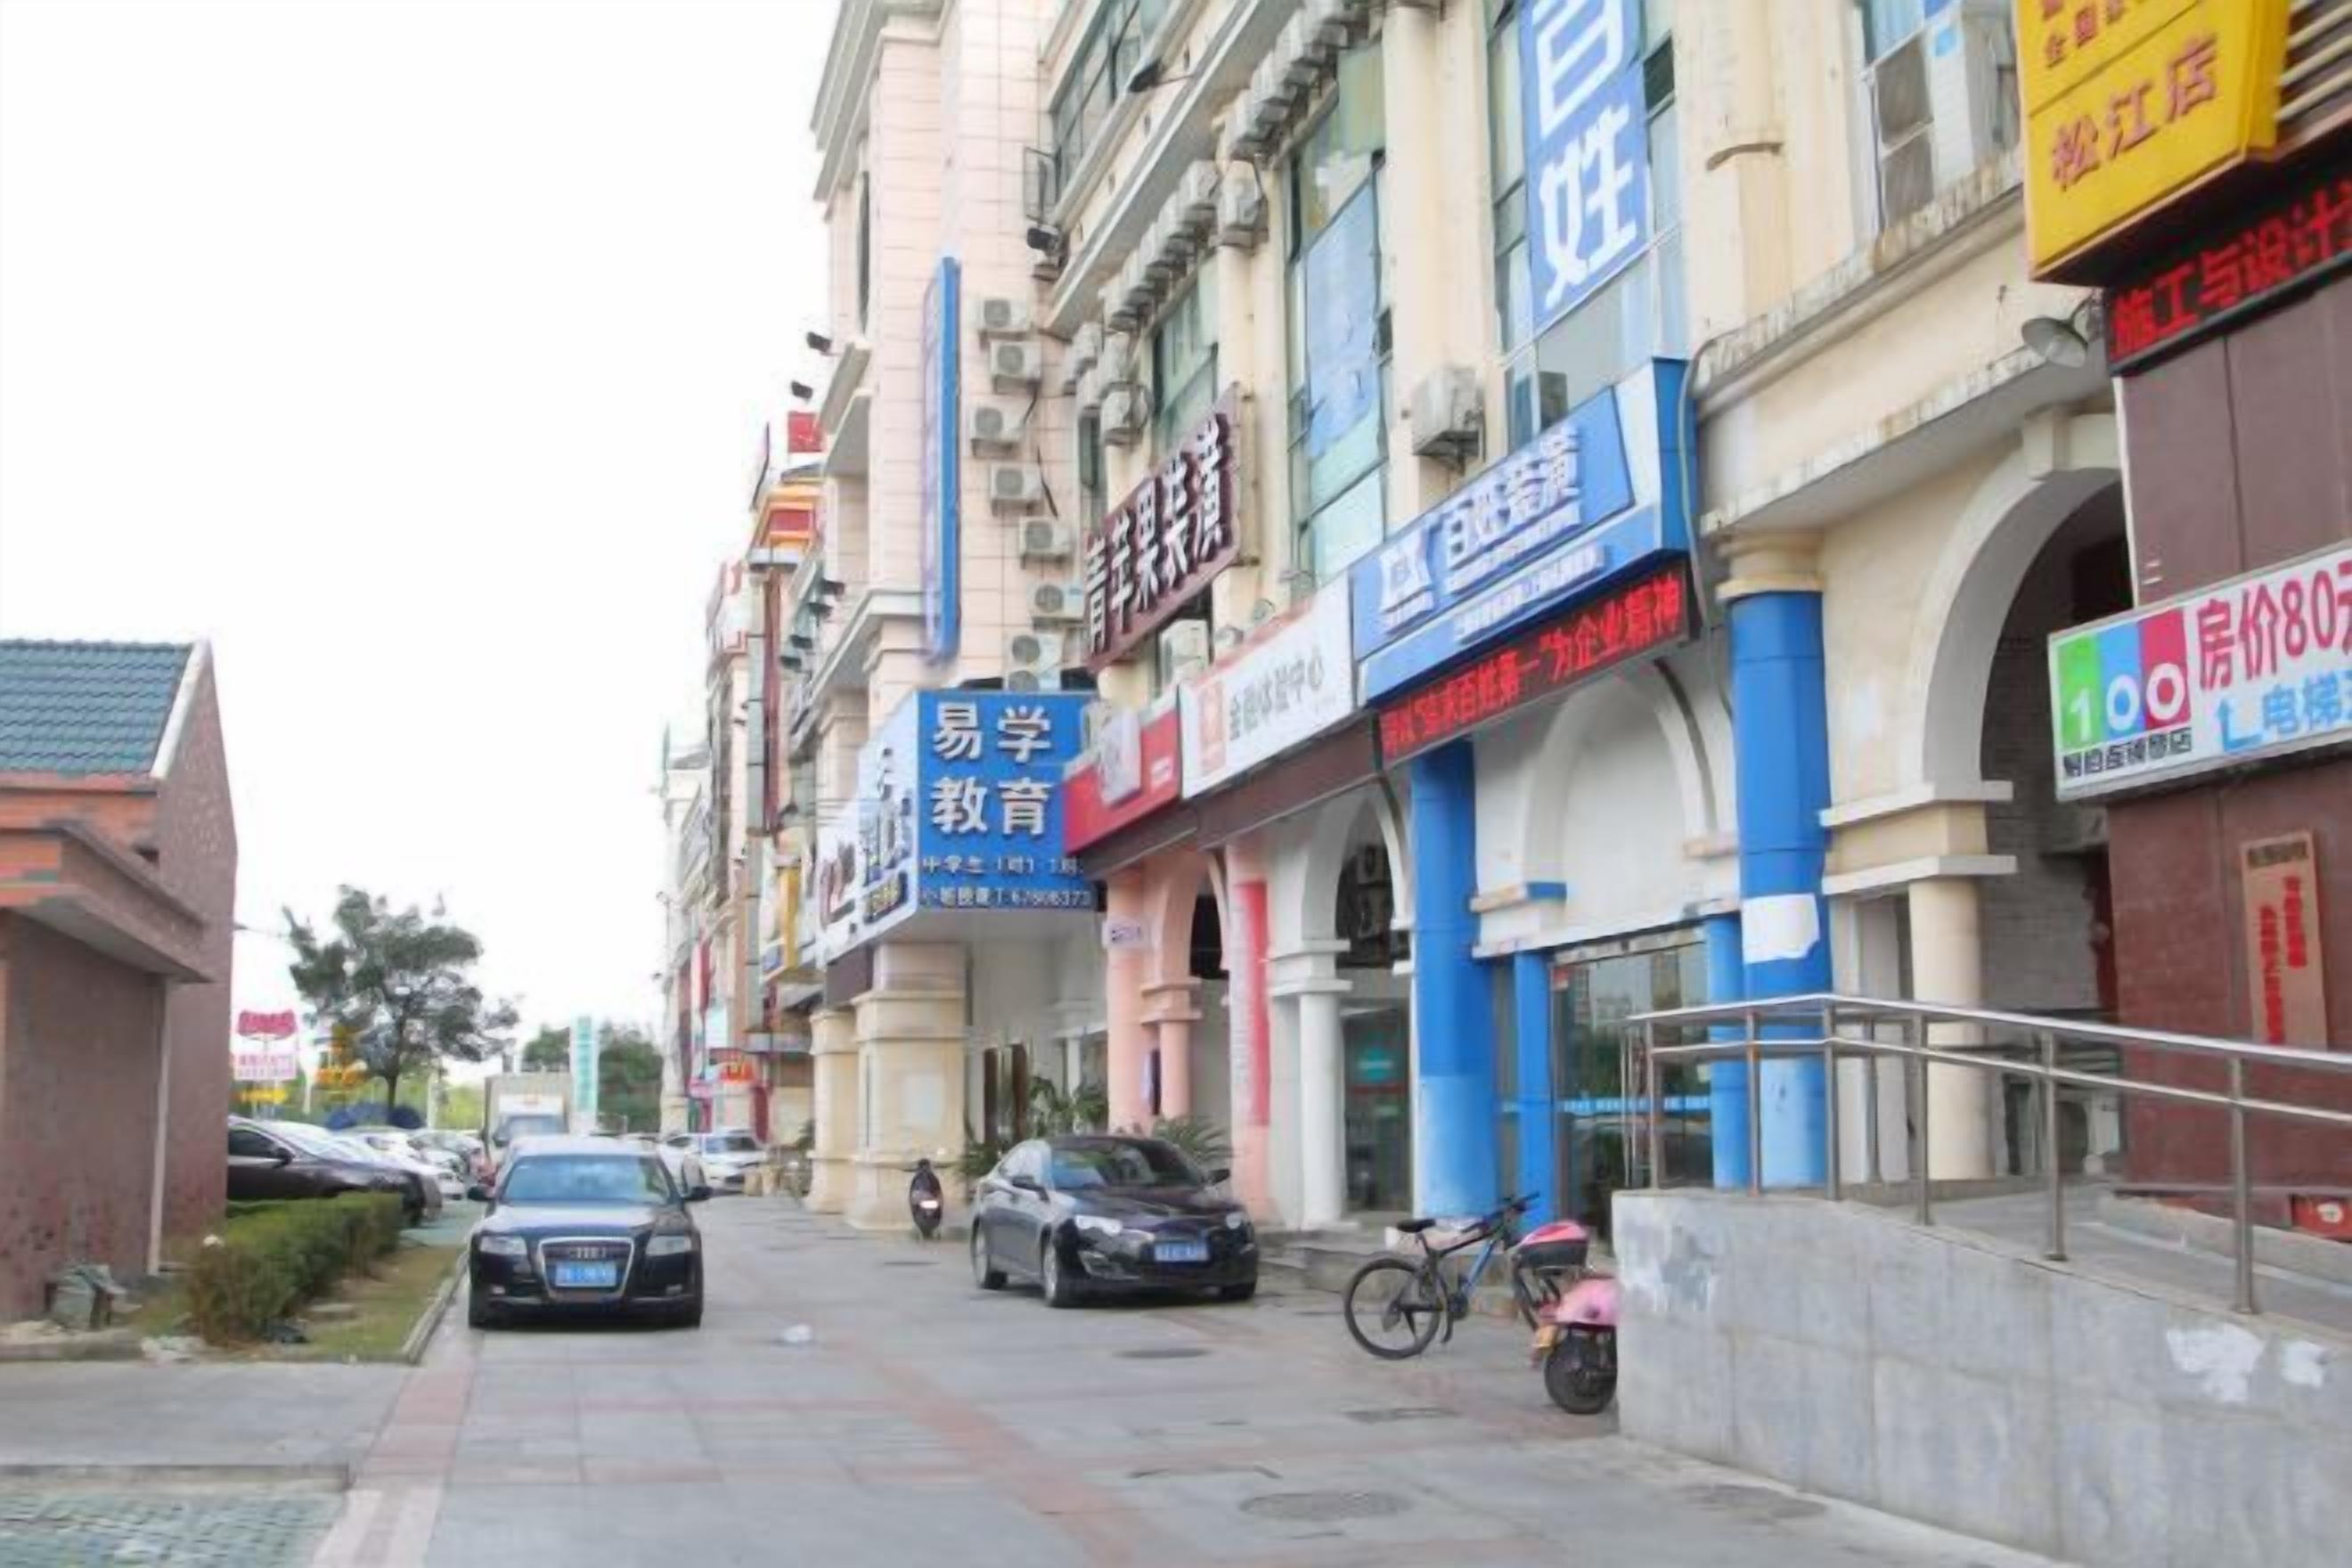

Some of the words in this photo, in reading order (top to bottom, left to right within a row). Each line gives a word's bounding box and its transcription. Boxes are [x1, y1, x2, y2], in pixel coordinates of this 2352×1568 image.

[2052, 32, 2217, 192] 松江店
[933, 701, 1052, 764] 易学
[2070, 662, 2185, 742] 100
[2262, 666, 2352, 736] 电梯
[931, 776, 1053, 835] 教育
